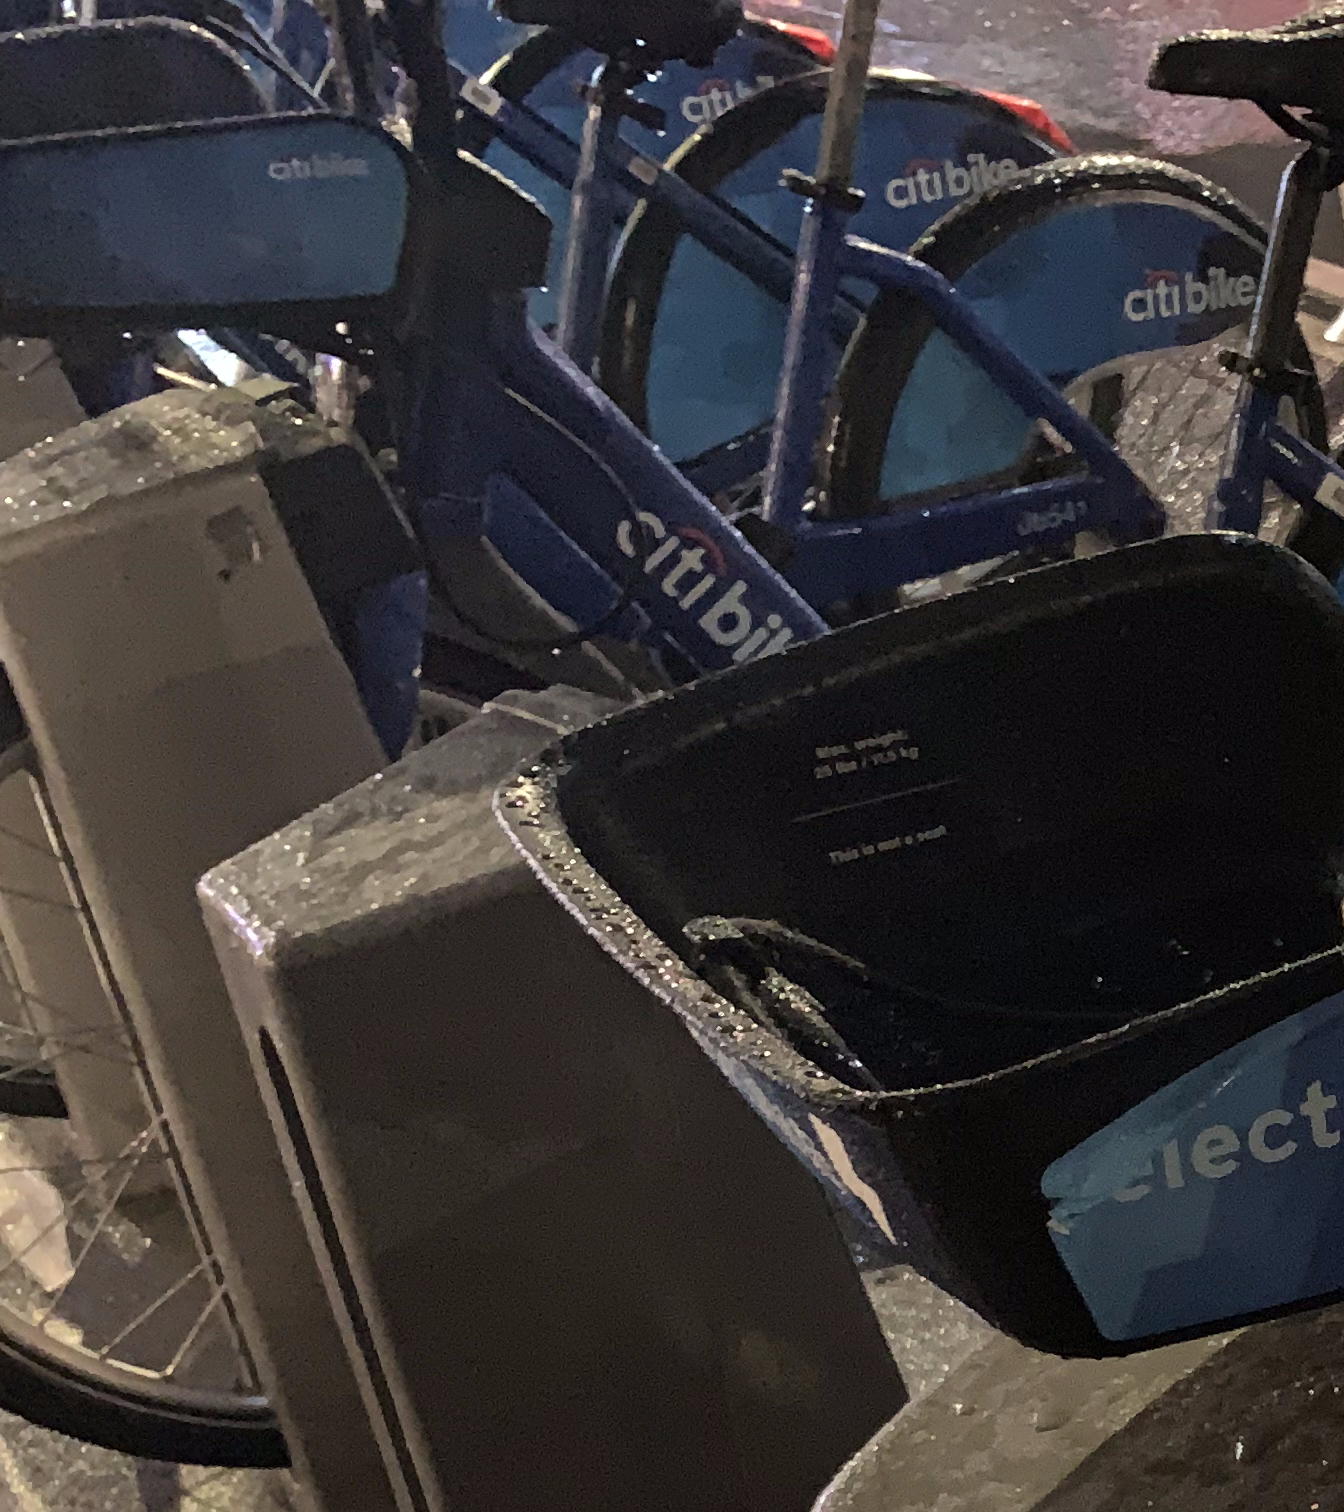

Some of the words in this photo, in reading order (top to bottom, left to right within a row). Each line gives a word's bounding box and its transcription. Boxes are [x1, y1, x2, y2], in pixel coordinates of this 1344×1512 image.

[1184, 266, 1258, 315] bike
[616, 511, 727, 611] citi
[698, 579, 796, 662] bik
